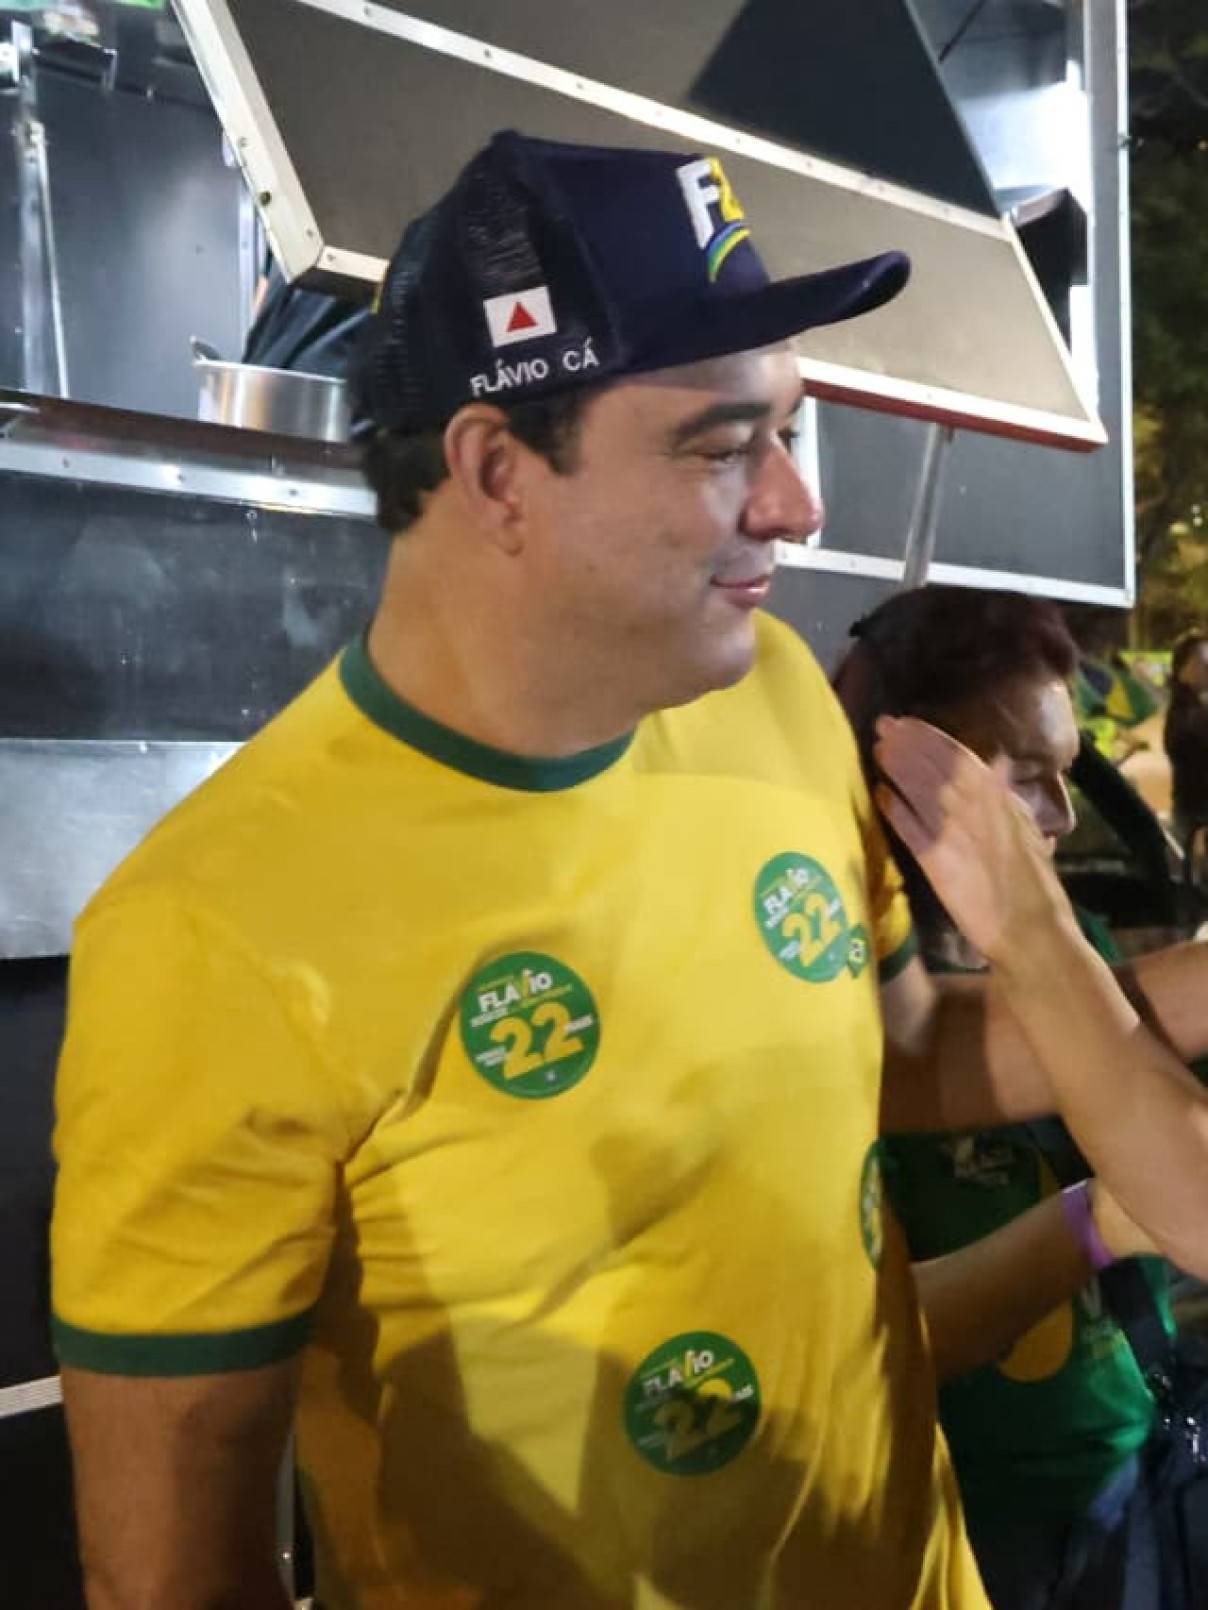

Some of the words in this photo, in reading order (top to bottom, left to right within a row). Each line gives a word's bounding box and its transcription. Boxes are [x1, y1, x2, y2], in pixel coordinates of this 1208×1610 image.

[470, 358, 550, 397] FLÁVIO
[562, 336, 600, 372] CÁ
[782, 892, 841, 968] 22
[490, 1001, 585, 1080] 22
[654, 1378, 742, 1463] 22
